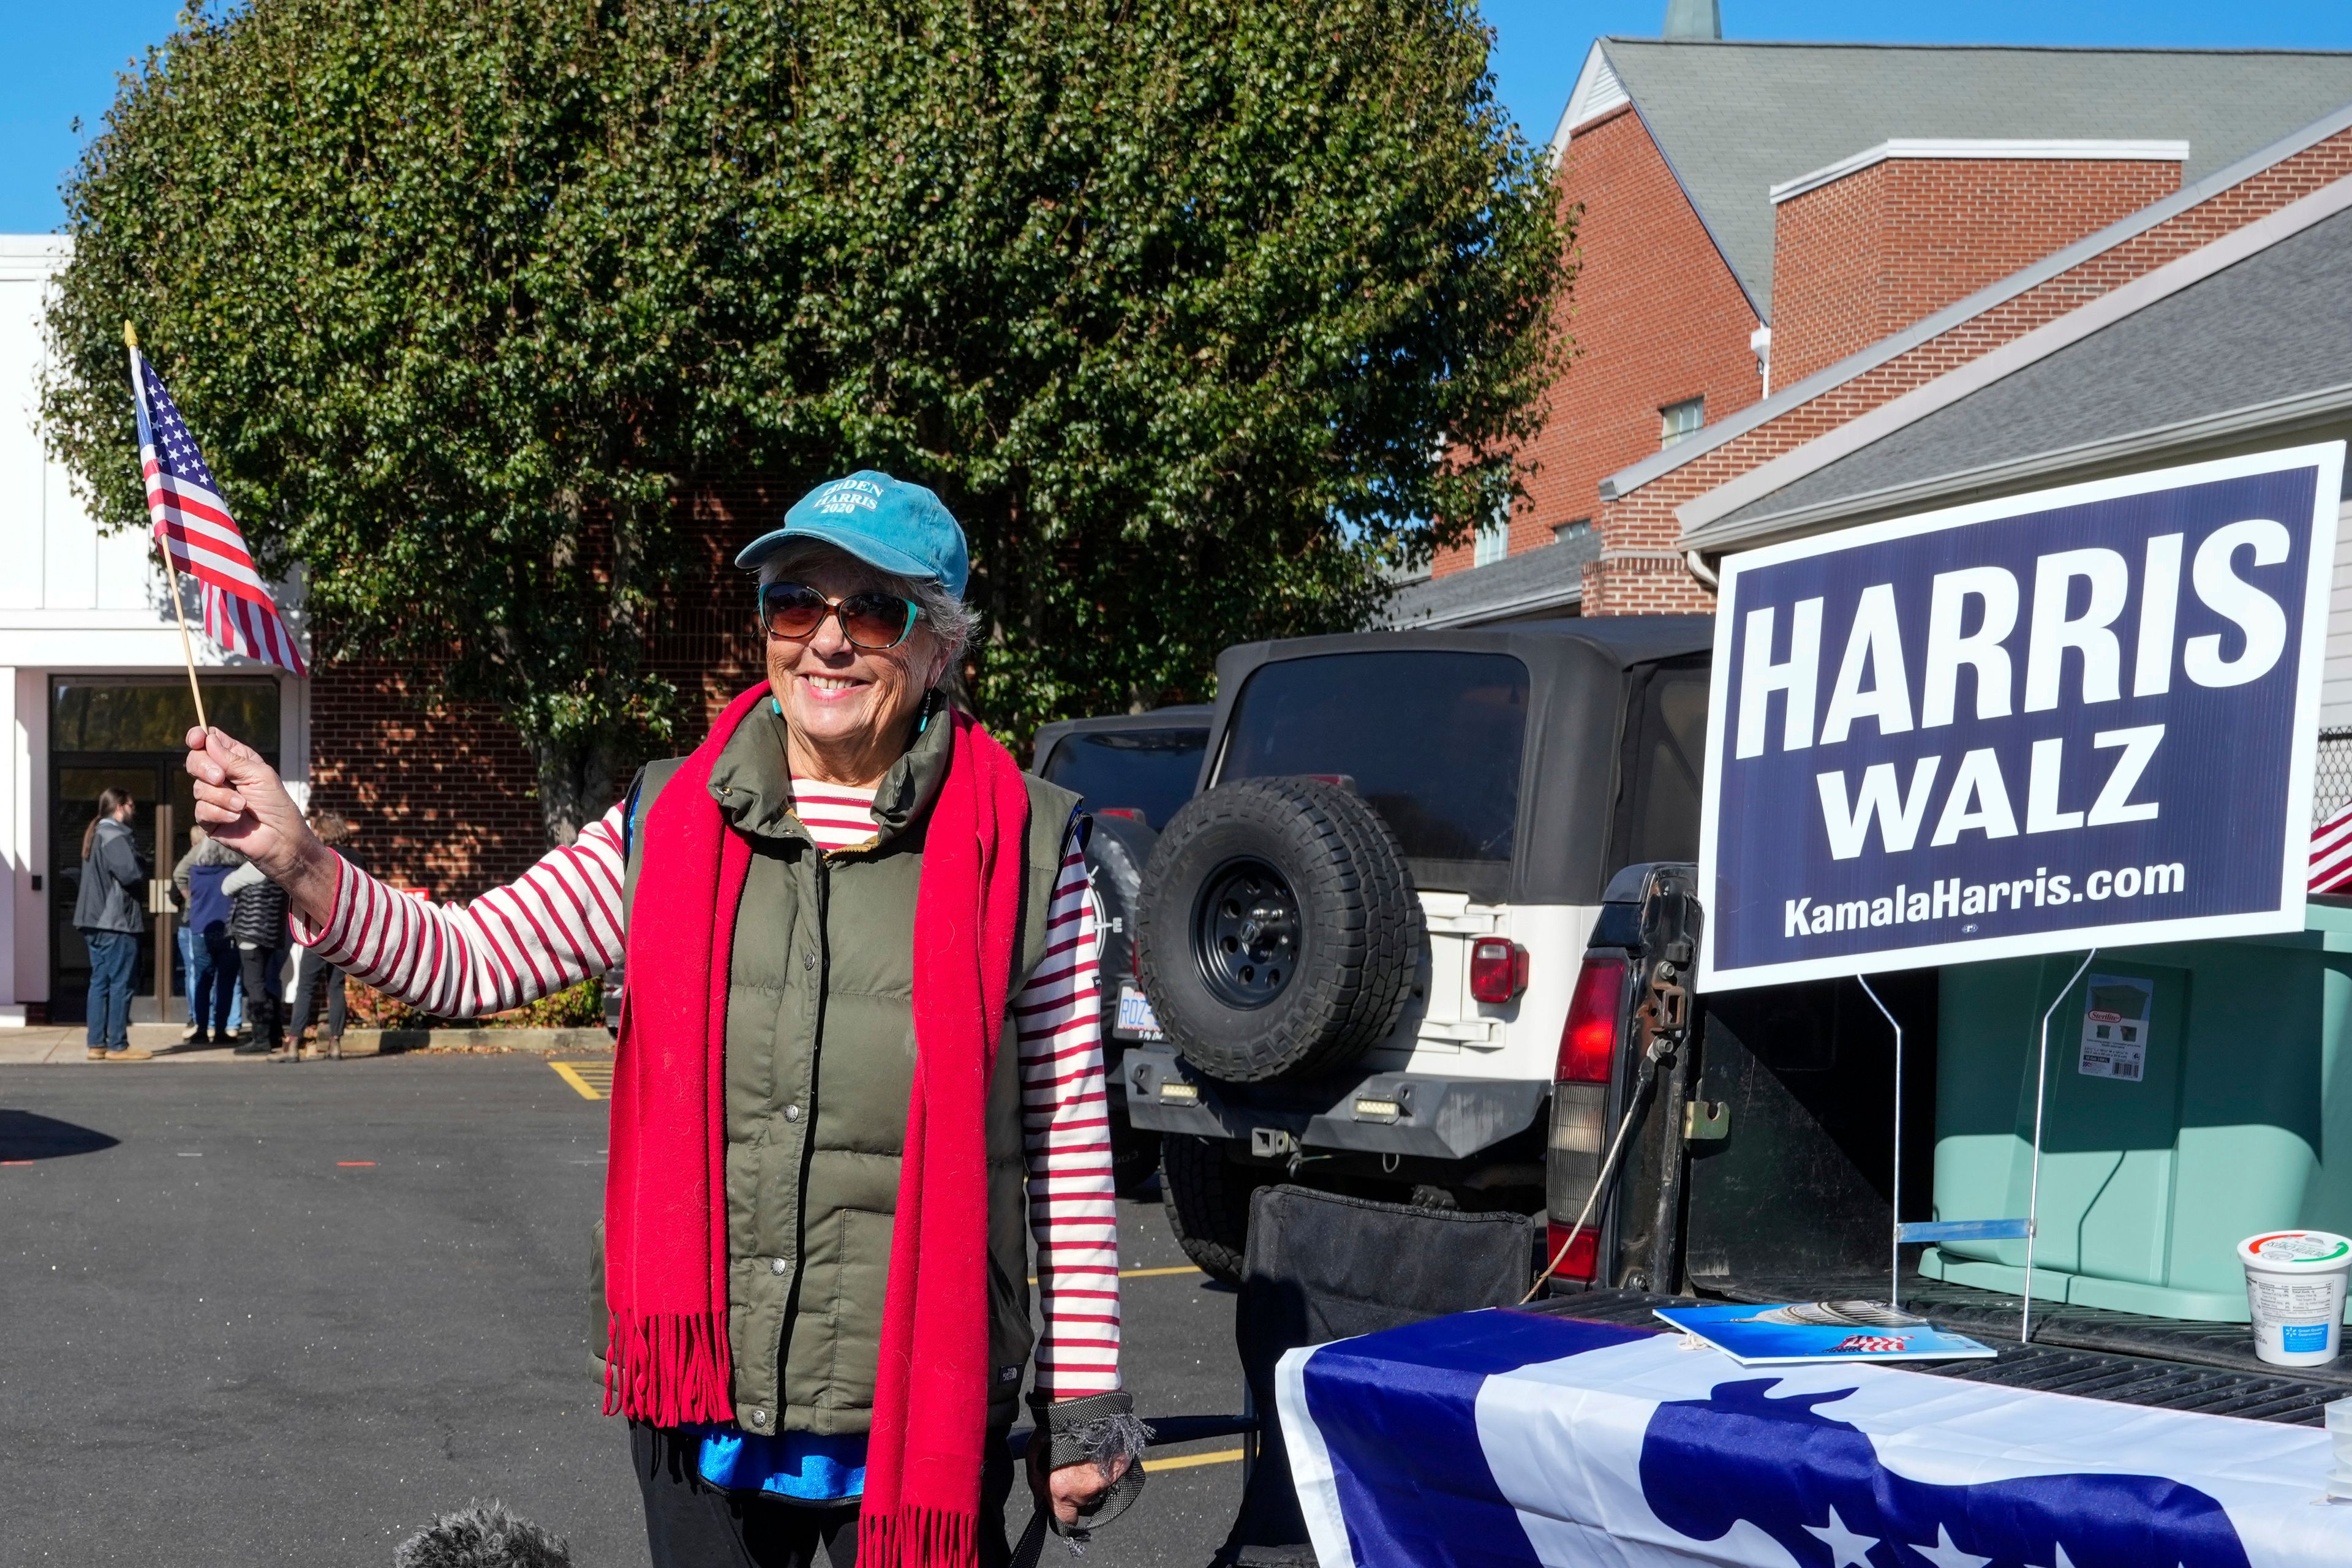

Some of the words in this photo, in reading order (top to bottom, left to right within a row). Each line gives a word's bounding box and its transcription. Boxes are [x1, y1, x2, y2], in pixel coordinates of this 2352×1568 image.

[813, 494, 878, 510] HARRIS
[821, 503, 856, 514] 2020
[822, 480, 884, 498] BIDEN
[1736, 517, 2290, 760] HARRIS
[1817, 724, 2165, 860] WALZ
[1785, 863, 2184, 937] KamalaHarris.com
